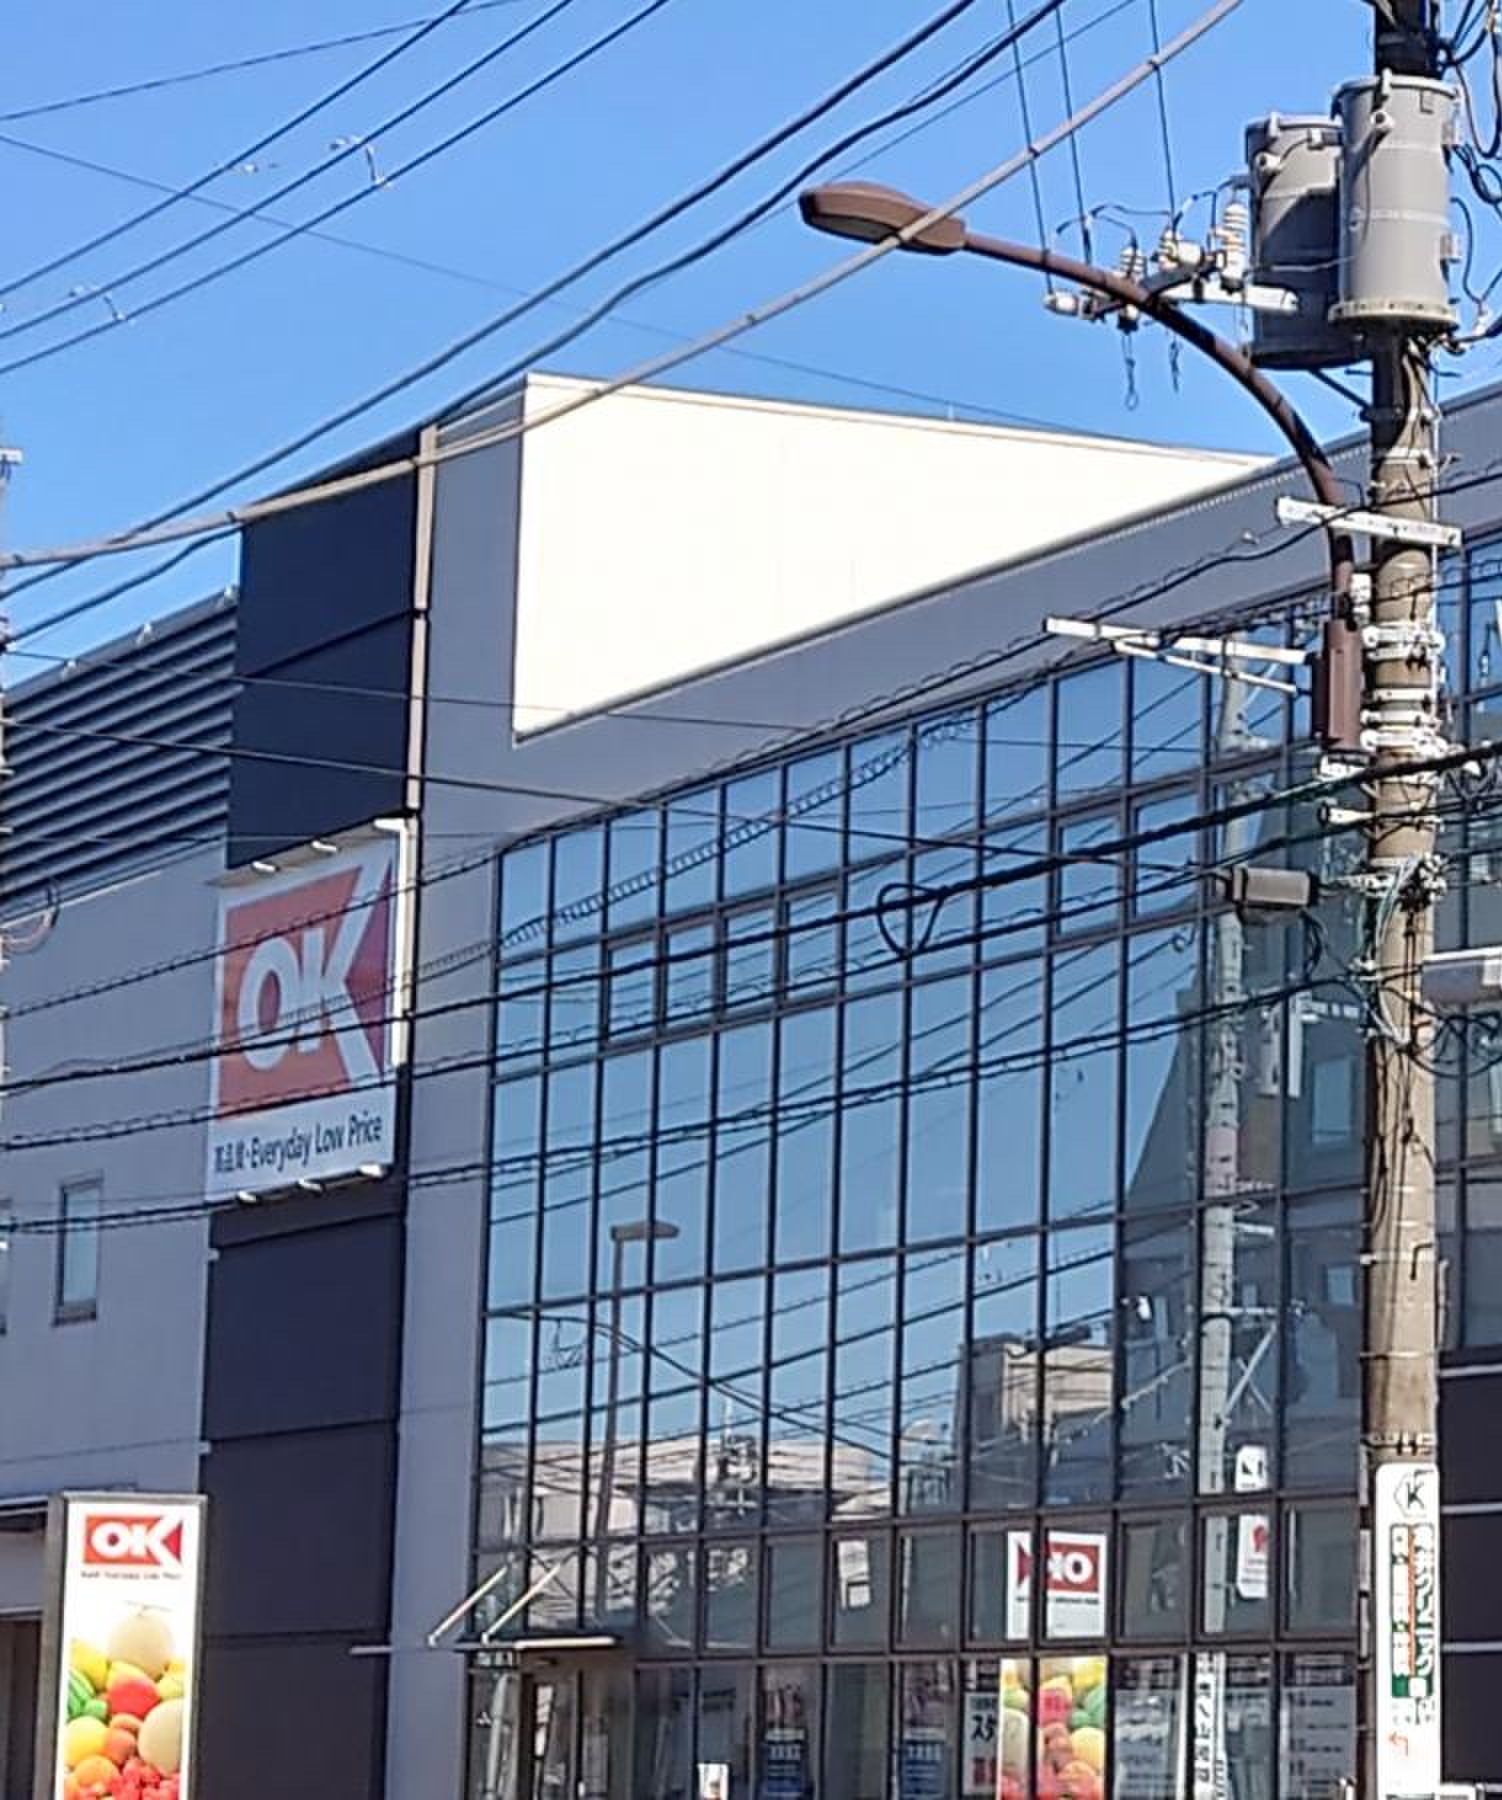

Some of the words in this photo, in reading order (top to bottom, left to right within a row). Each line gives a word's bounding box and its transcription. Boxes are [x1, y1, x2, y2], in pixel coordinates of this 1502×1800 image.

[238, 854, 389, 1083] OK
[316, 1121, 346, 1154] Low
[348, 1109, 383, 1147] Price
[90, 1515, 184, 1566] OK
